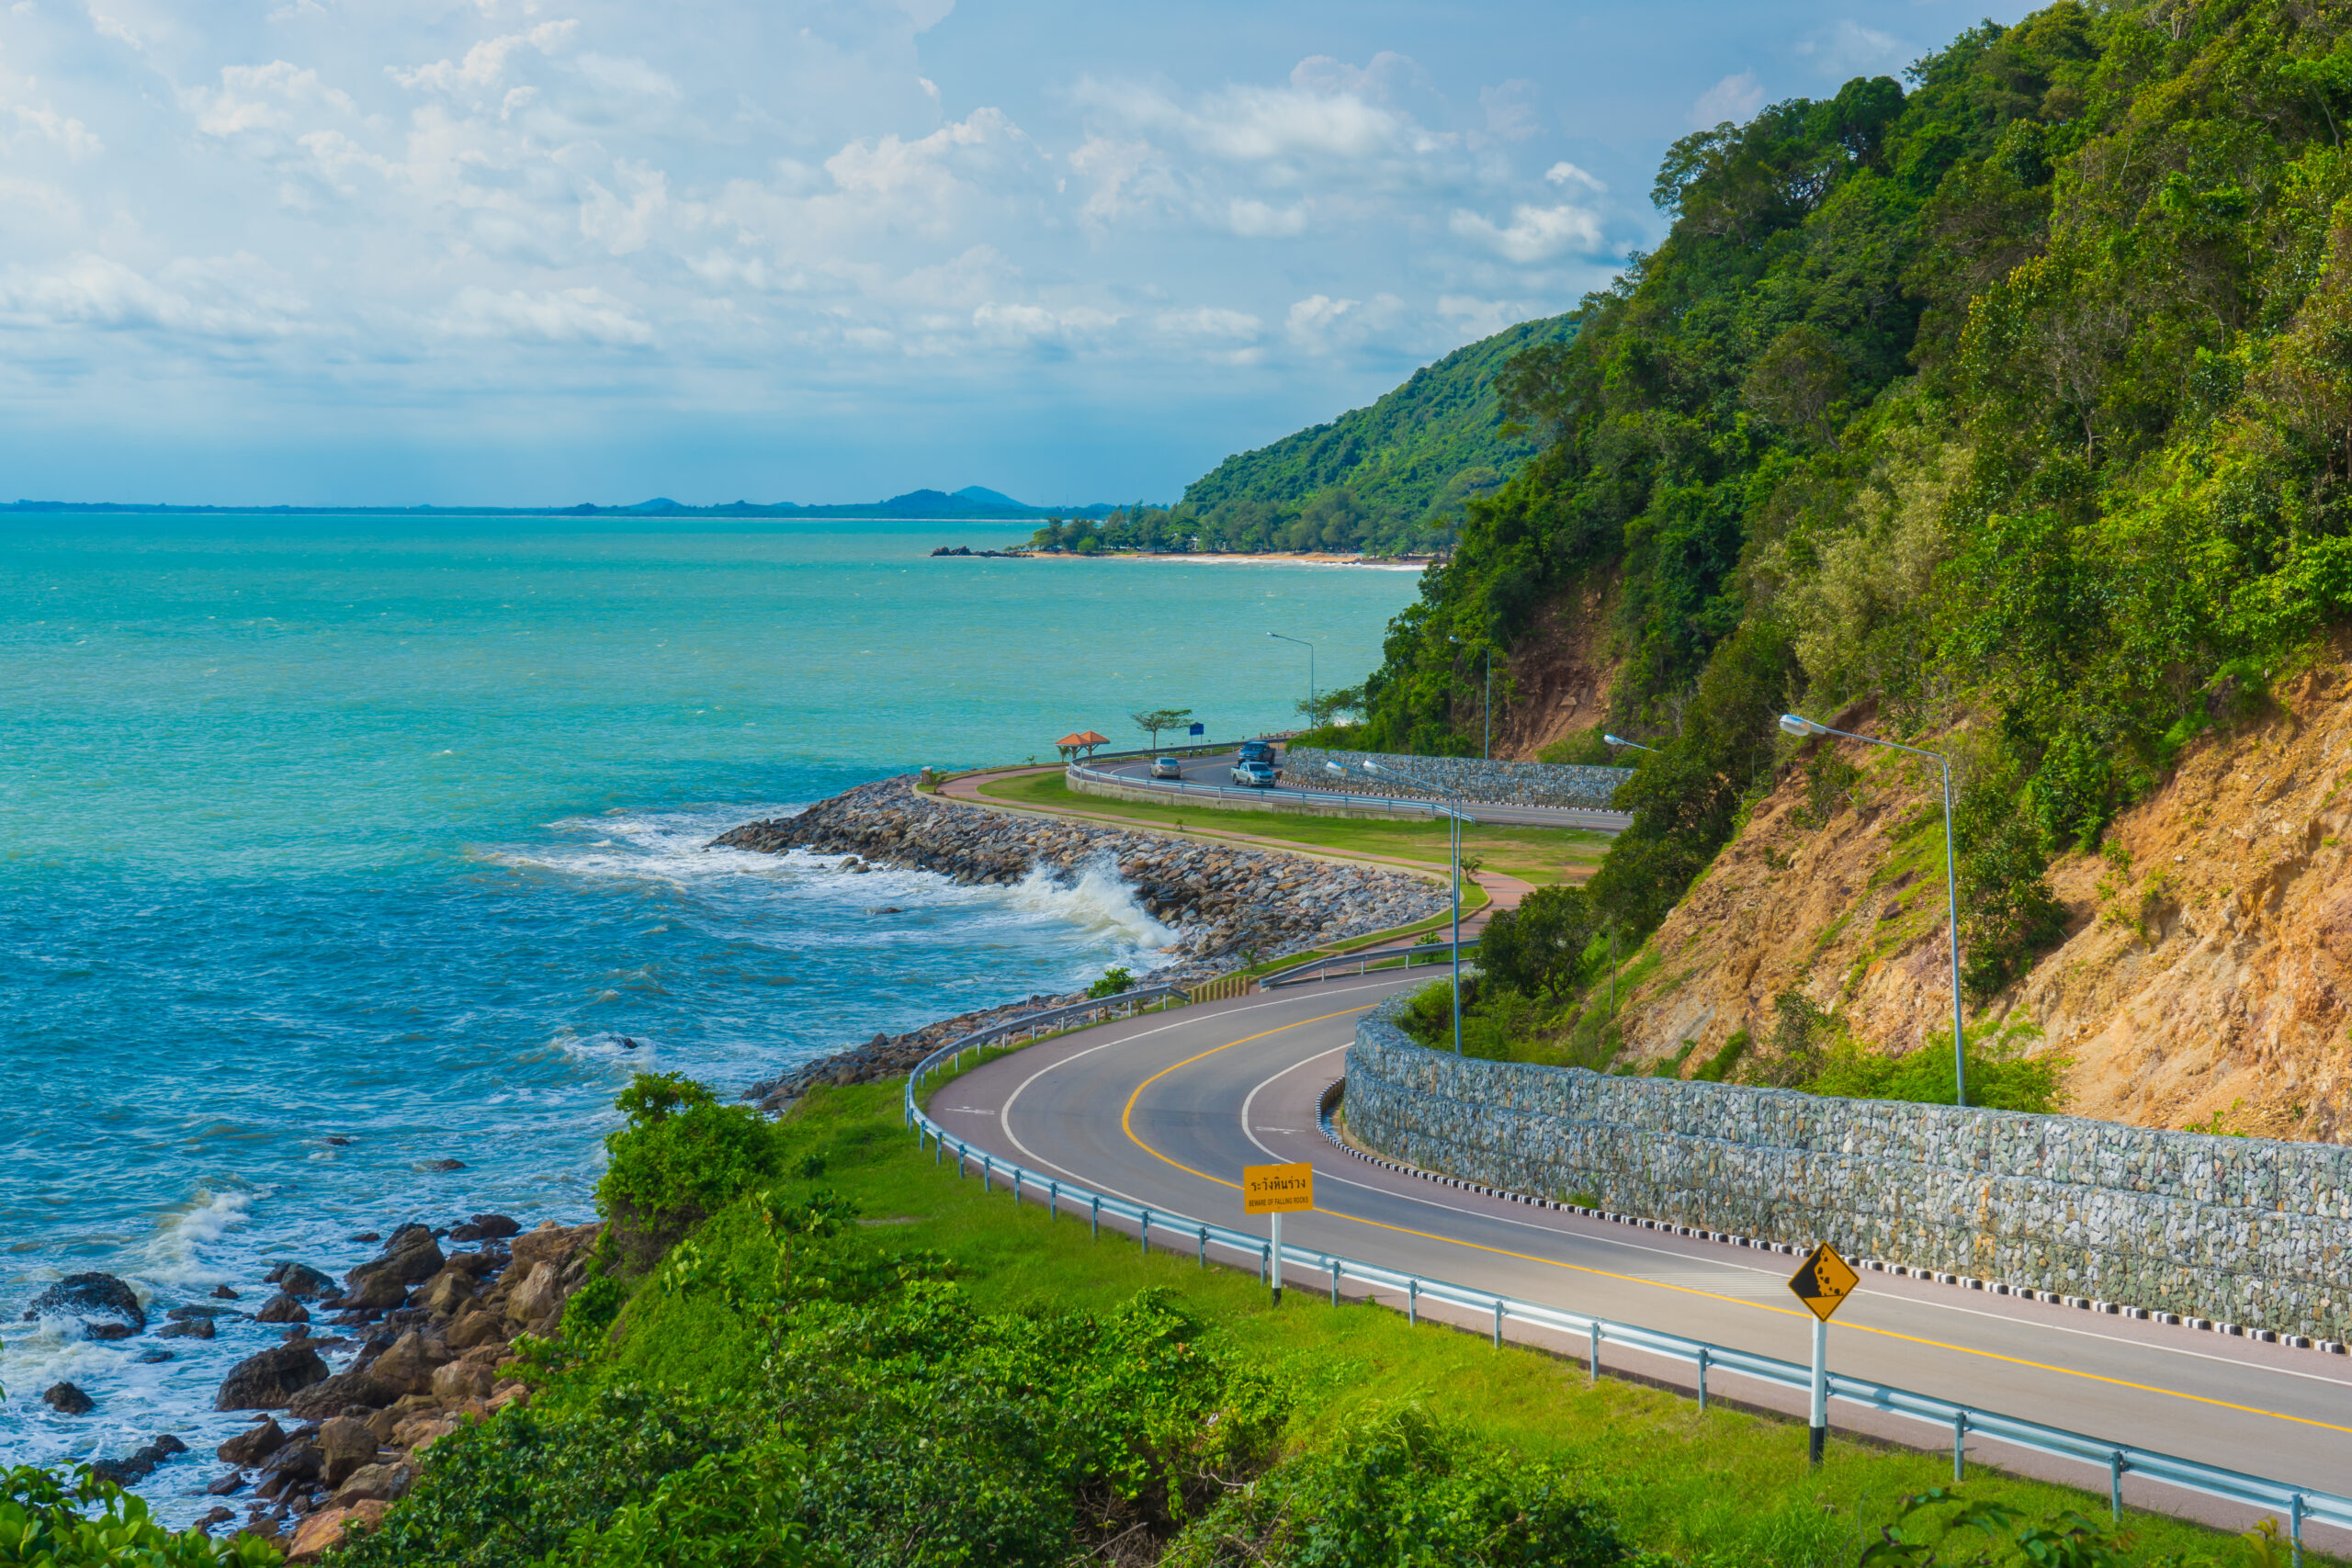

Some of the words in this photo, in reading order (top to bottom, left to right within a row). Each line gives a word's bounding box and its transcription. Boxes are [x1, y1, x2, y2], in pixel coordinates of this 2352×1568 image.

[1250, 1176, 1306, 1191] ระวังหินร่วง
[1249, 1199, 1266, 1207] BEWARE
[1274, 1197, 1293, 1205] FALLING
